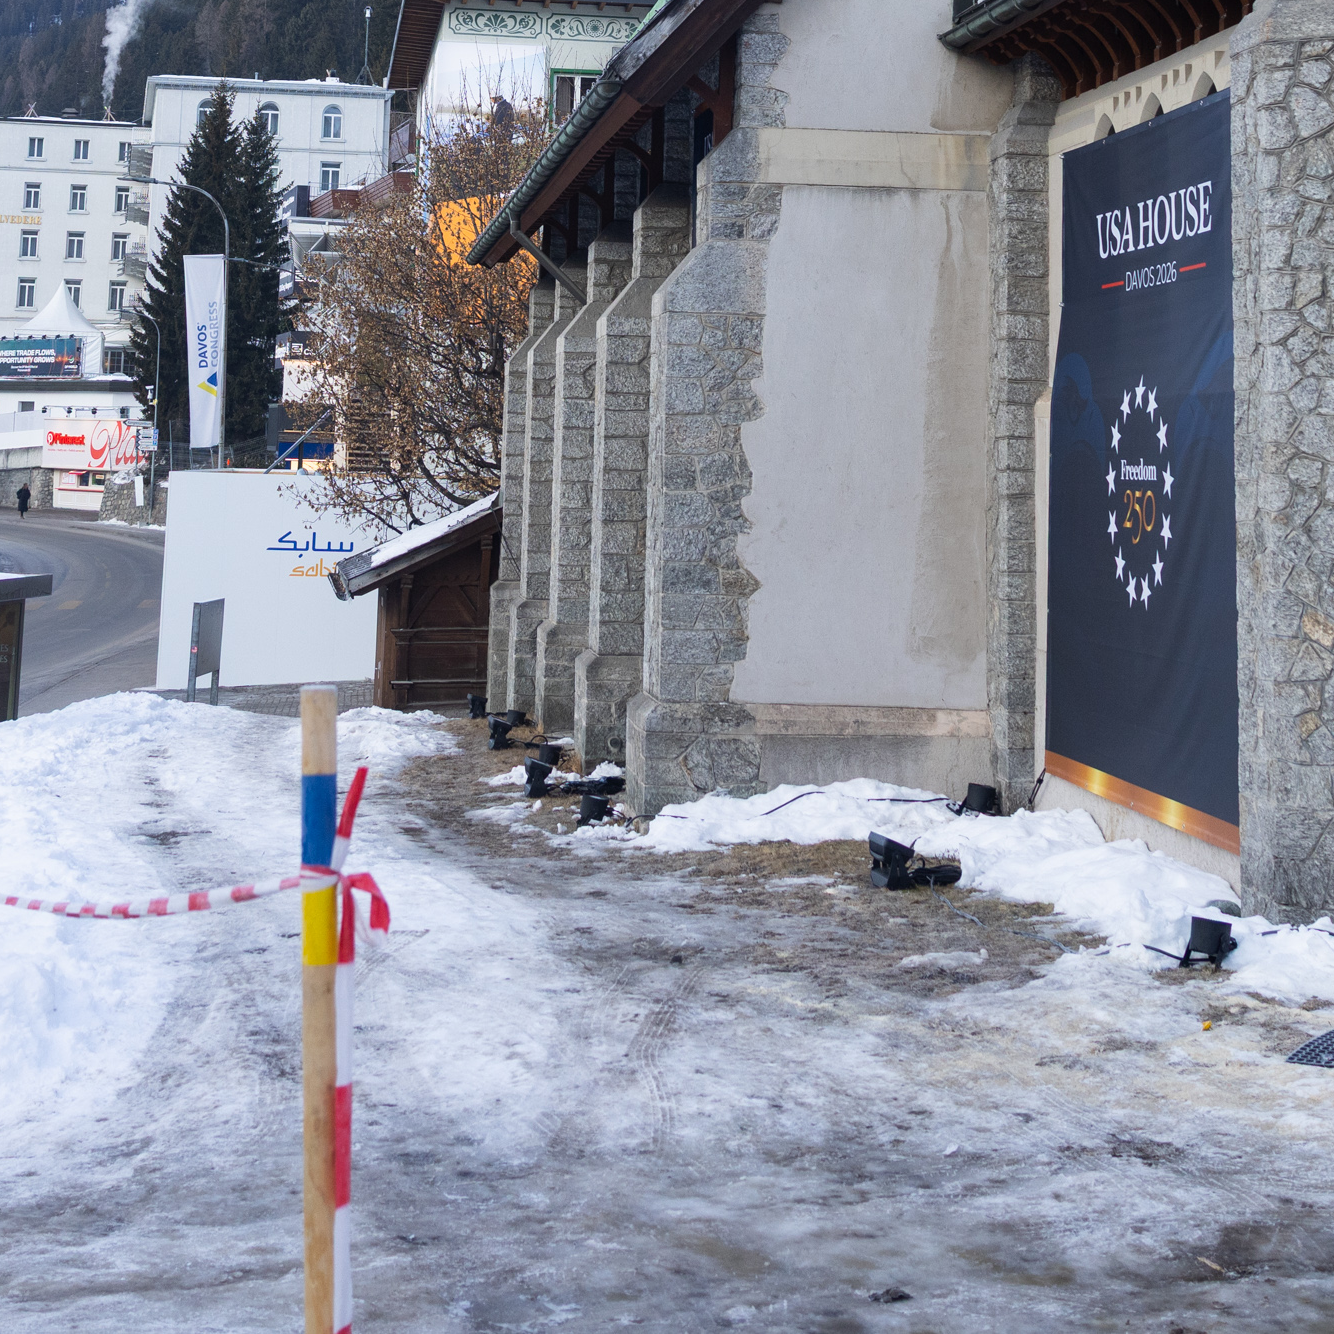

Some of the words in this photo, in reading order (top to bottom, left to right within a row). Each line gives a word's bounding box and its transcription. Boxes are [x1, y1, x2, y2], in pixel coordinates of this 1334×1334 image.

[1096, 206, 1135, 259] USA
[1137, 180, 1212, 250] HOUSE
[1125, 266, 1155, 291] DAVOS
[1156, 261, 1177, 285] 2026
[197, 324, 208, 368] DAVOS
[208, 301, 219, 368] CONGRESS
[53, 432, 85, 445] Pinterest
[1120, 458, 1157, 480] Freedom
[1123, 488, 1156, 544] 250
